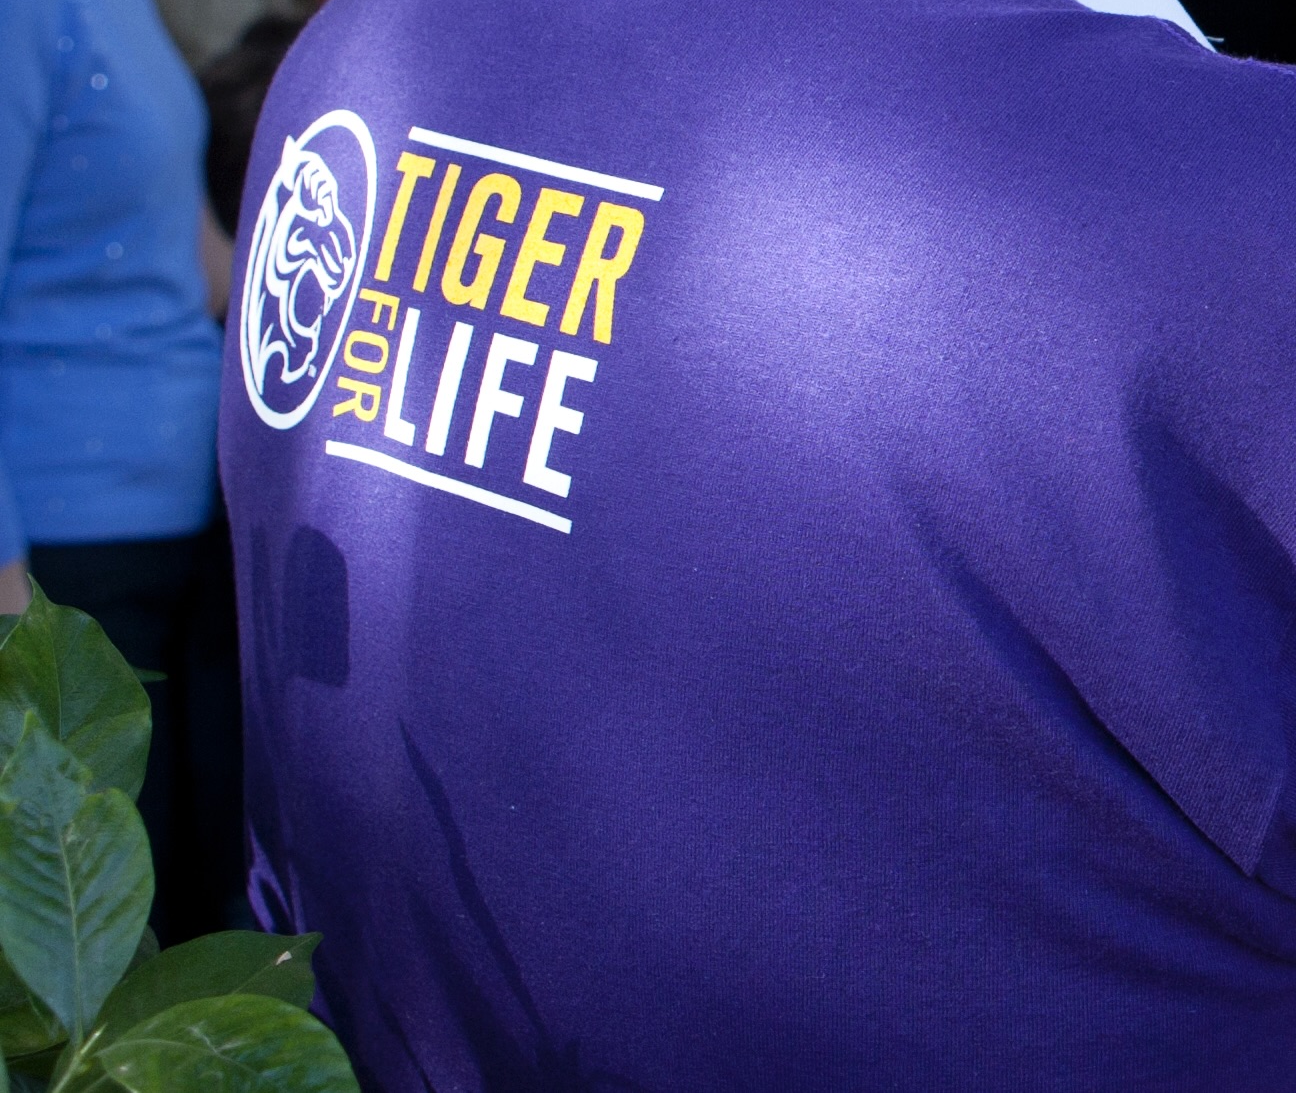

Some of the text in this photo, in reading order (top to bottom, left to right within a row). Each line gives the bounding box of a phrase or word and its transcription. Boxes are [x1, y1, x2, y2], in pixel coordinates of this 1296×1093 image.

[374, 151, 645, 344] TIGER
[333, 288, 400, 423] FOR
[384, 307, 599, 498] LIFE
